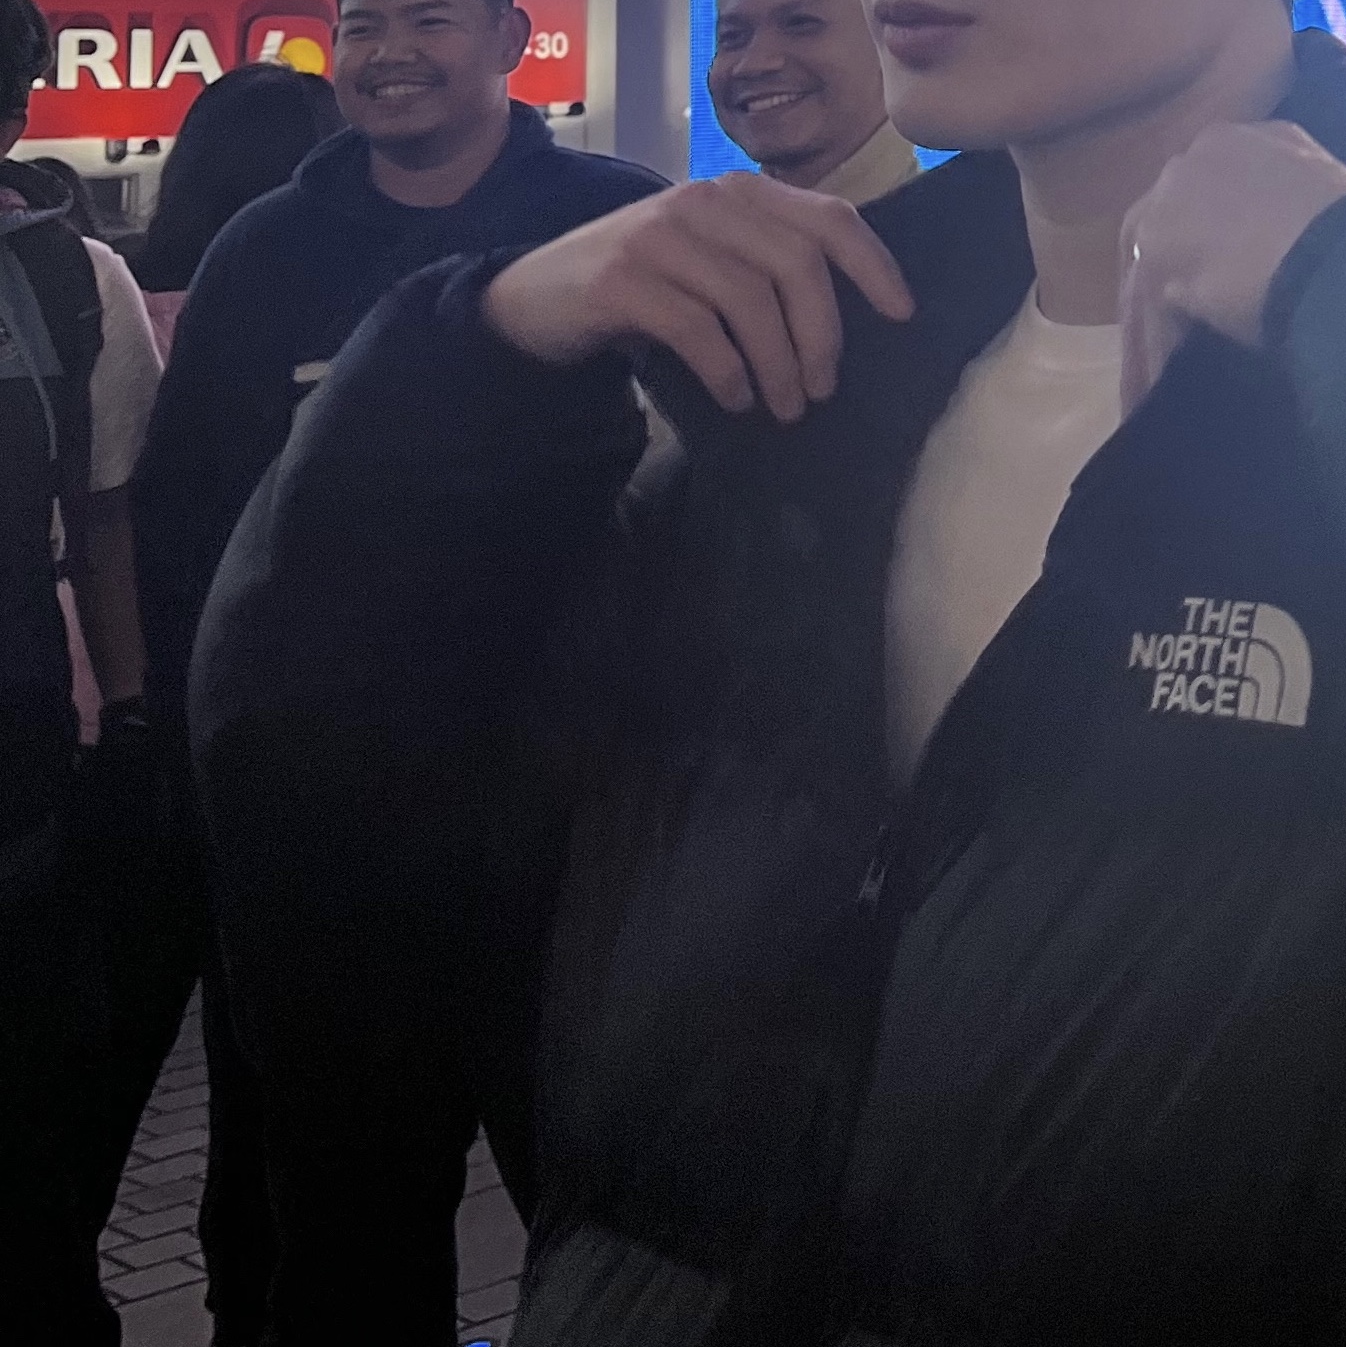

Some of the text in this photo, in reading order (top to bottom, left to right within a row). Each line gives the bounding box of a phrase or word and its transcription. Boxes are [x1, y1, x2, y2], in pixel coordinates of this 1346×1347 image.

[32, 28, 224, 91] RIA
[1184, 597, 1255, 638] THE
[1128, 632, 1247, 675] NORTH
[1150, 672, 1240, 716] FACE
